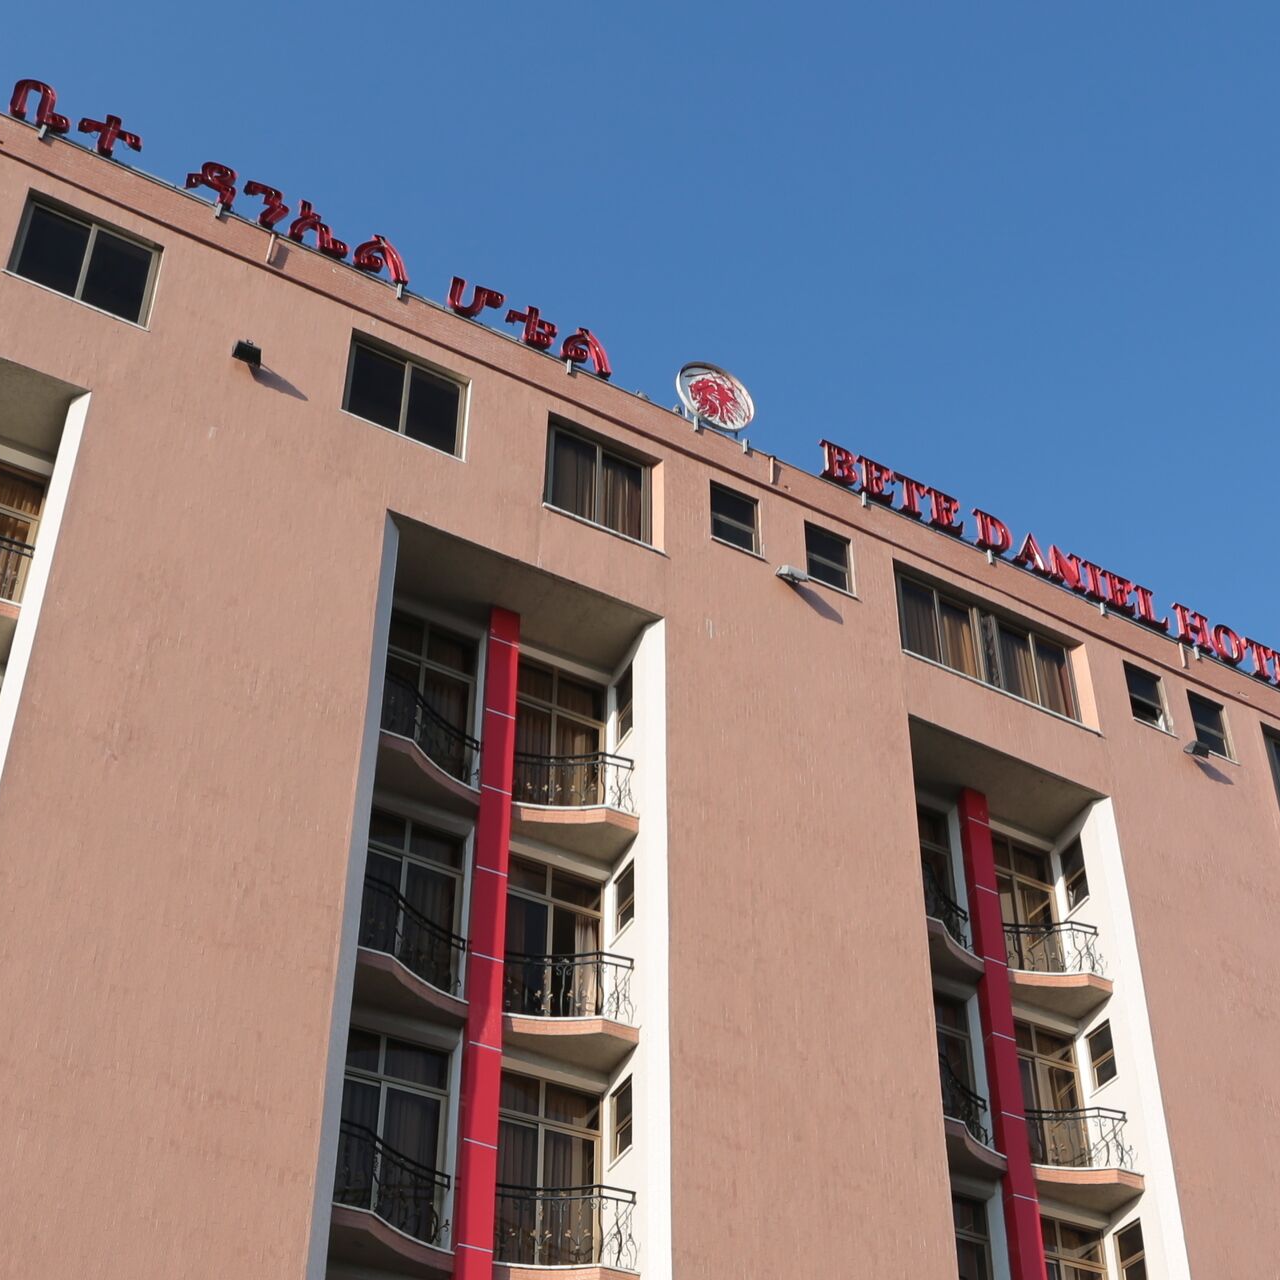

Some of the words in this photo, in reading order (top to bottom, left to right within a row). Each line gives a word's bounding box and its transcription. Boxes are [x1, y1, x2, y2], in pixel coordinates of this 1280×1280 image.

[9, 79, 142, 157] ቤተ
[184, 161, 409, 287] ዳንኤል
[447, 276, 612, 380] ሆቴል
[819, 438, 965, 536] BETE
[971, 507, 1170, 634] DANIEL
